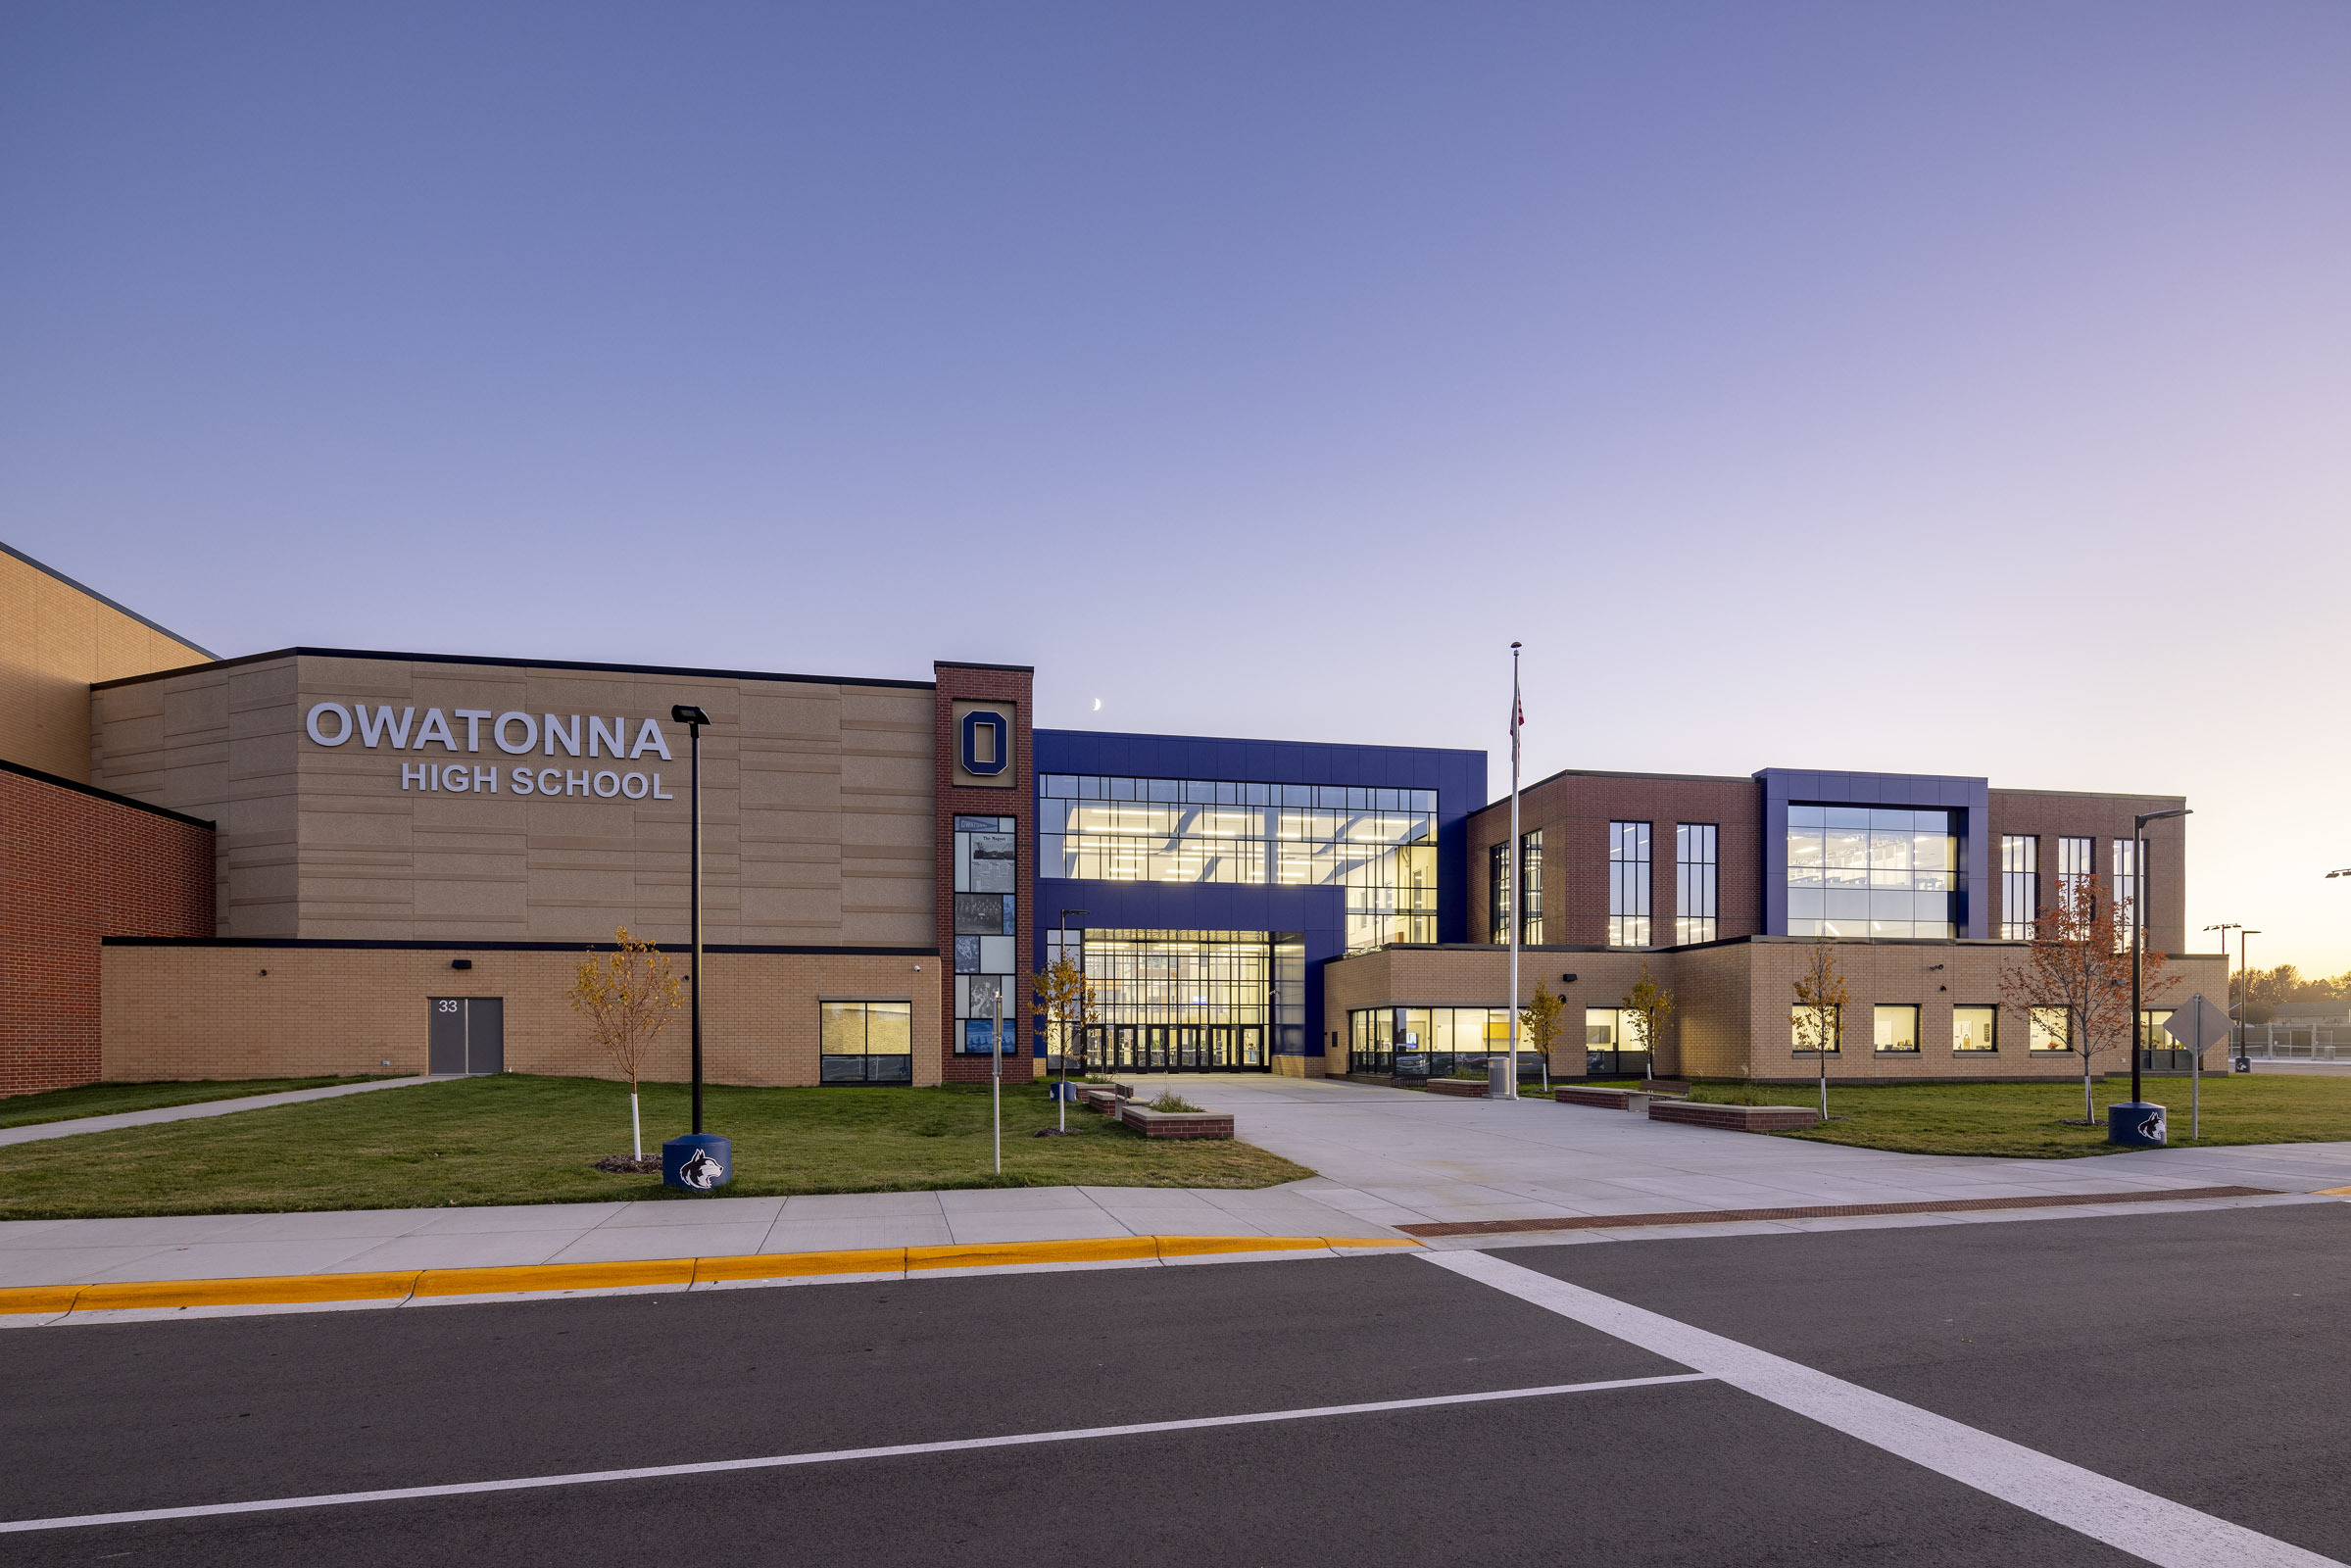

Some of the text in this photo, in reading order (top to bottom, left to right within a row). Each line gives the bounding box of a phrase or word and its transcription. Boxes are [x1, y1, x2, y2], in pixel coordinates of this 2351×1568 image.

[306, 703, 673, 760] OWATONNA
[961, 710, 1008, 776] O
[402, 762, 673, 800] HIGH SCHOOL
[438, 1000, 458, 1012] 33
